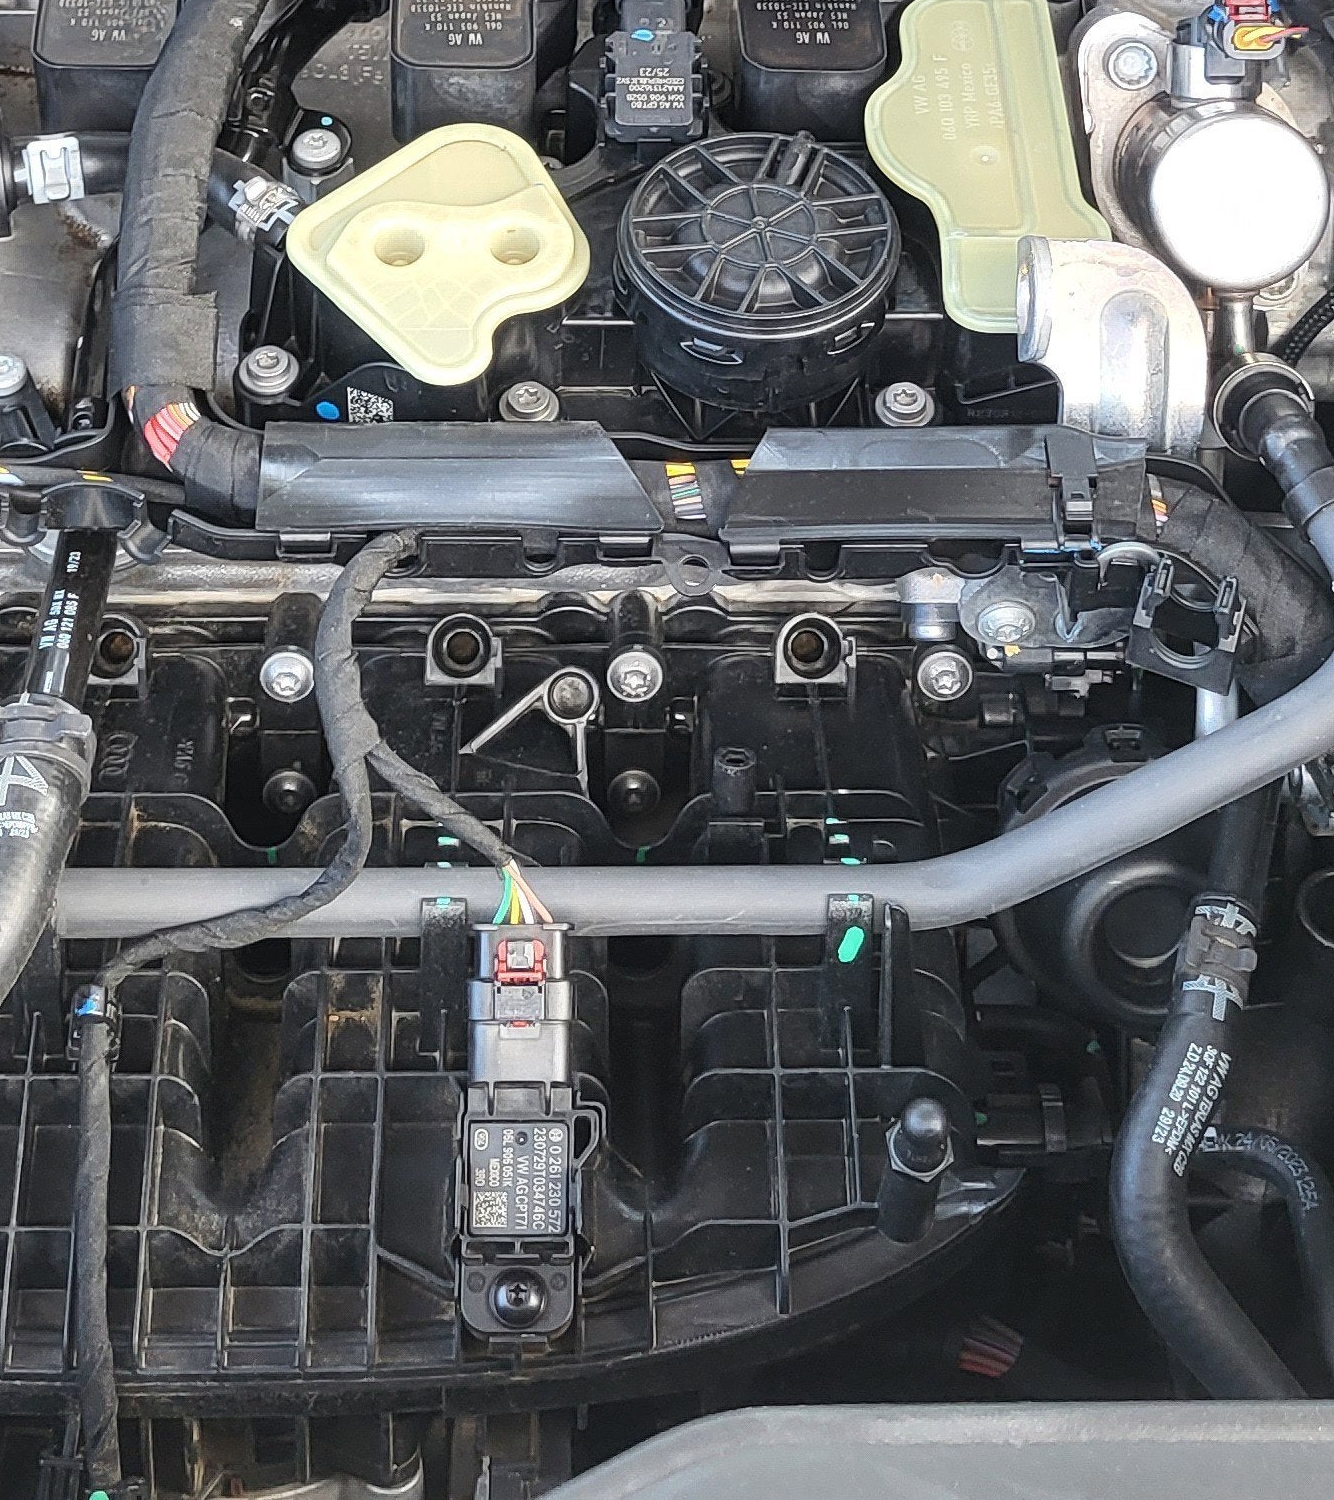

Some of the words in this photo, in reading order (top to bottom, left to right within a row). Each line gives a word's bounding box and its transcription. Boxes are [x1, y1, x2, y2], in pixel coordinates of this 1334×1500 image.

[90, 29, 106, 40] AG
[112, 29, 125, 40] VW
[447, 33, 462, 44] AG
[468, 32, 482, 44] VW
[795, 32, 809, 43] AG
[816, 32, 830, 43] VW
[639, 67, 669, 75] 25/23
[912, 75, 926, 90] AG
[961, 63, 975, 100] Mexico
[913, 95, 930, 114] VW
[42, 617, 58, 632] AG
[38, 634, 55, 650] VW
[1214, 1051, 1232, 1076] VW
[1193, 1065, 1209, 1085] 122
[1186, 1083, 1201, 1103] 101
[1205, 1072, 1223, 1099] AG
[1181, 1101, 1192, 1110] L
[1151, 1107, 1175, 1144] 29/23
[1188, 1096, 1213, 1138] TEKLAS
[548, 1145, 560, 1154] 0
[516, 1155, 528, 1174] VW
[548, 1157, 560, 1178] 261
[515, 1177, 527, 1193] AG
[532, 1127, 545, 1229] 230729T034746C
[548, 1182, 560, 1205] 230
[548, 1209, 560, 1232] 572
